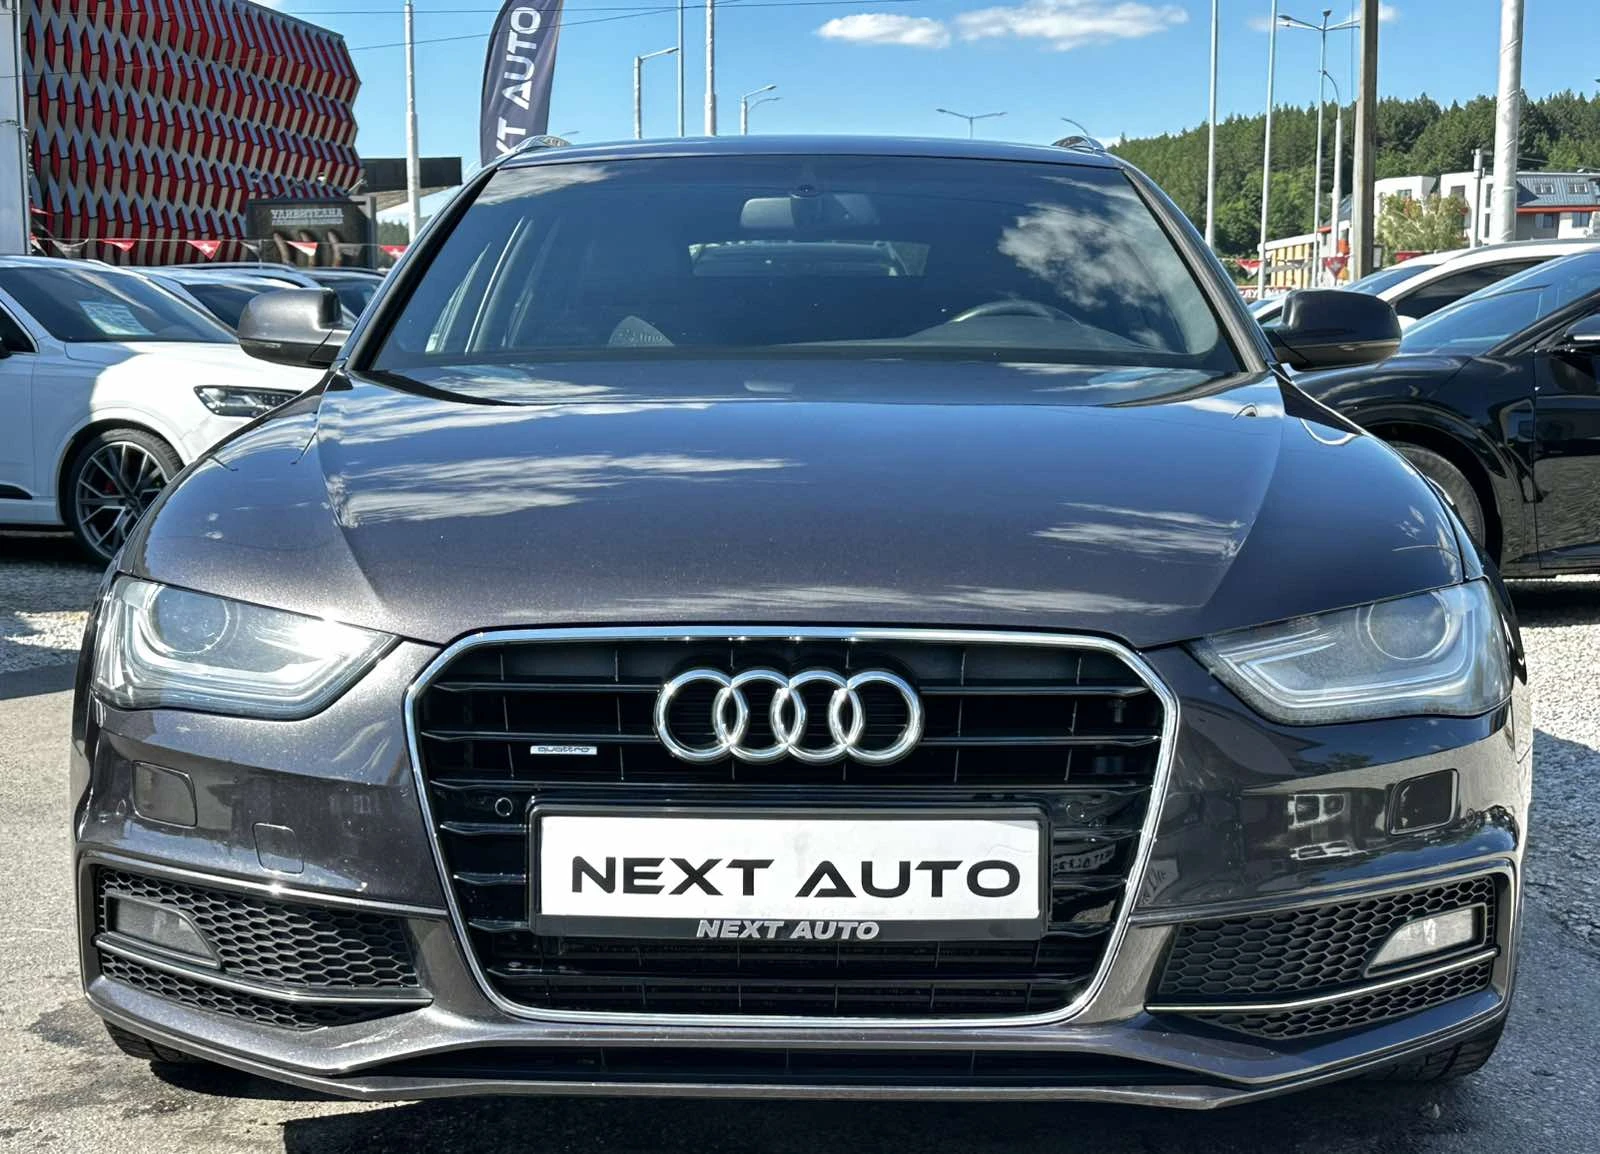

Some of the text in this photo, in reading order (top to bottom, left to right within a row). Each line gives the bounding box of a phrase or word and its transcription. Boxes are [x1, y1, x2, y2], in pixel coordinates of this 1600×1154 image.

[502, 7, 541, 110] AUTO
[537, 746, 590, 754] quattro
[571, 855, 1021, 898] NEXT AUTO
[696, 919, 880, 940] NEXT AUTO
